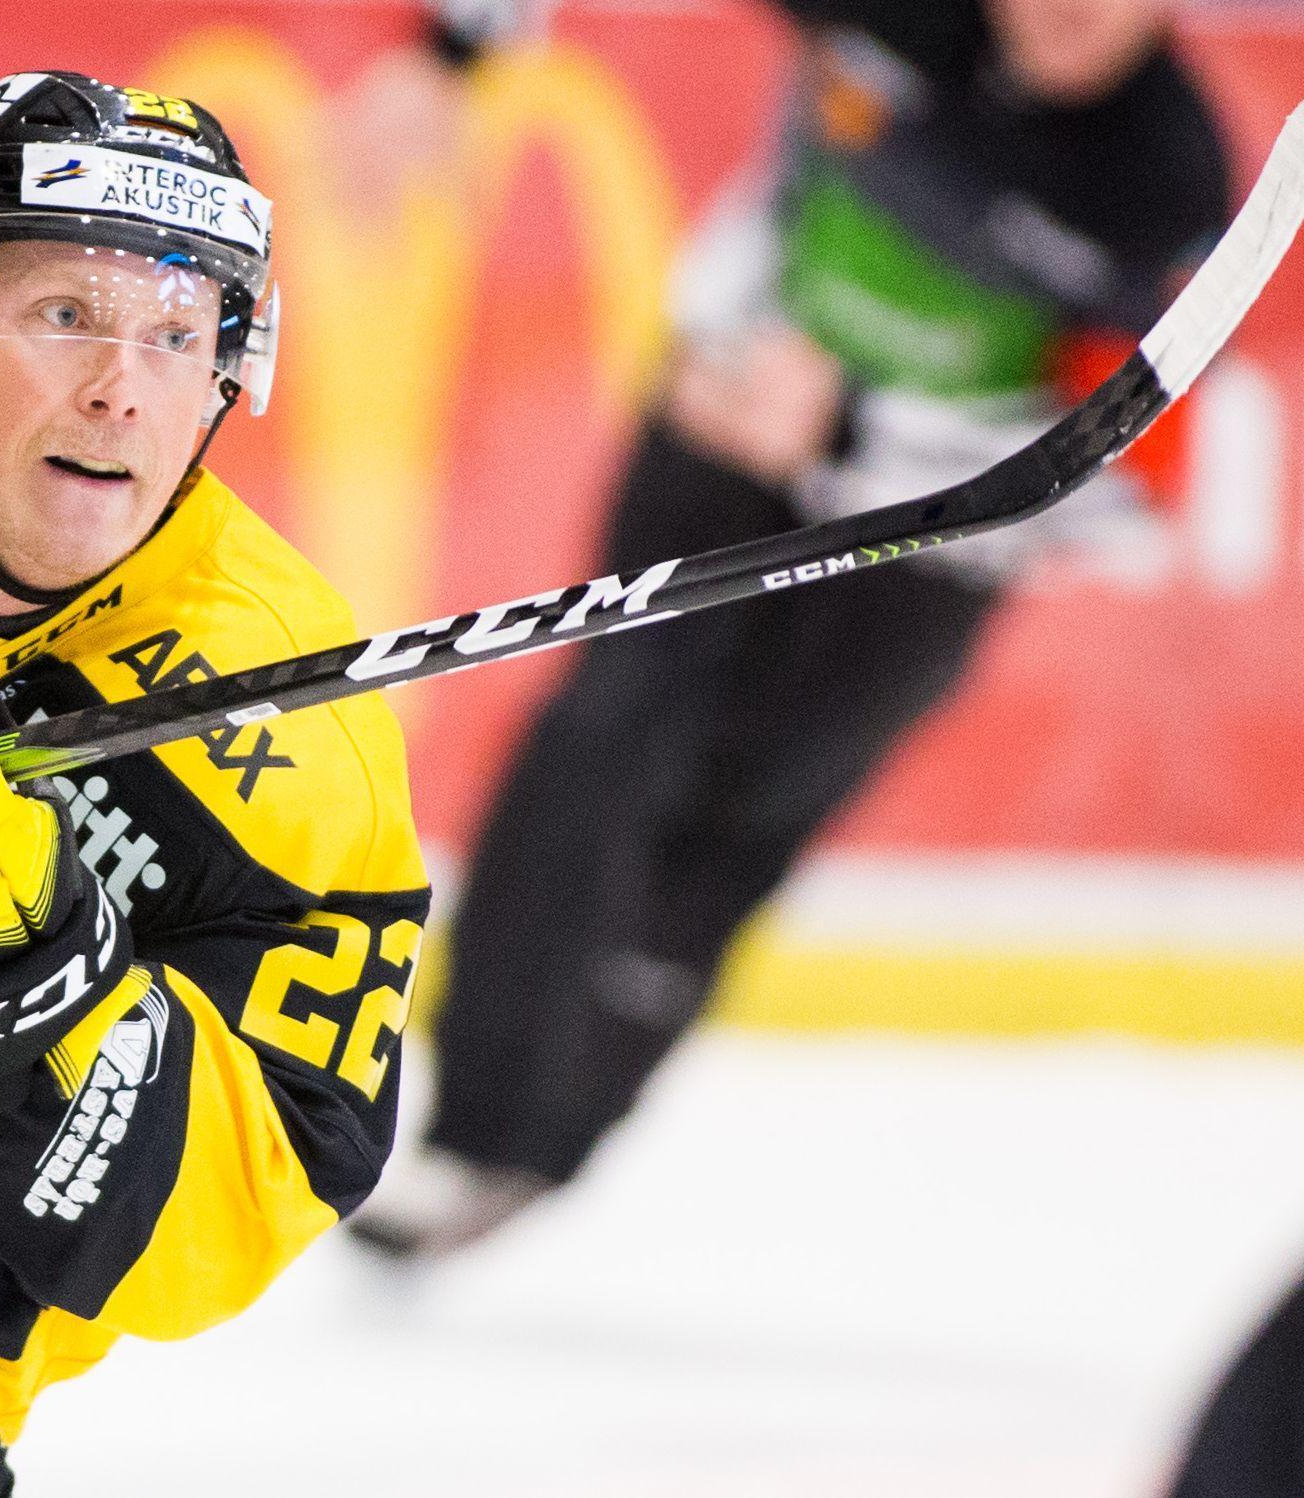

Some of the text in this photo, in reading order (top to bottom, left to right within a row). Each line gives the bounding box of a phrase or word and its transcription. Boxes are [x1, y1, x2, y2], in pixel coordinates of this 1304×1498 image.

[123, 87, 198, 131] 22
[104, 160, 228, 207] NTEROC
[101, 185, 223, 232] AKUSTIK
[762, 552, 856, 591] CCM
[5, 584, 123, 670] CCM
[345, 555, 681, 681] CCM
[239, 911, 424, 1104] 22
